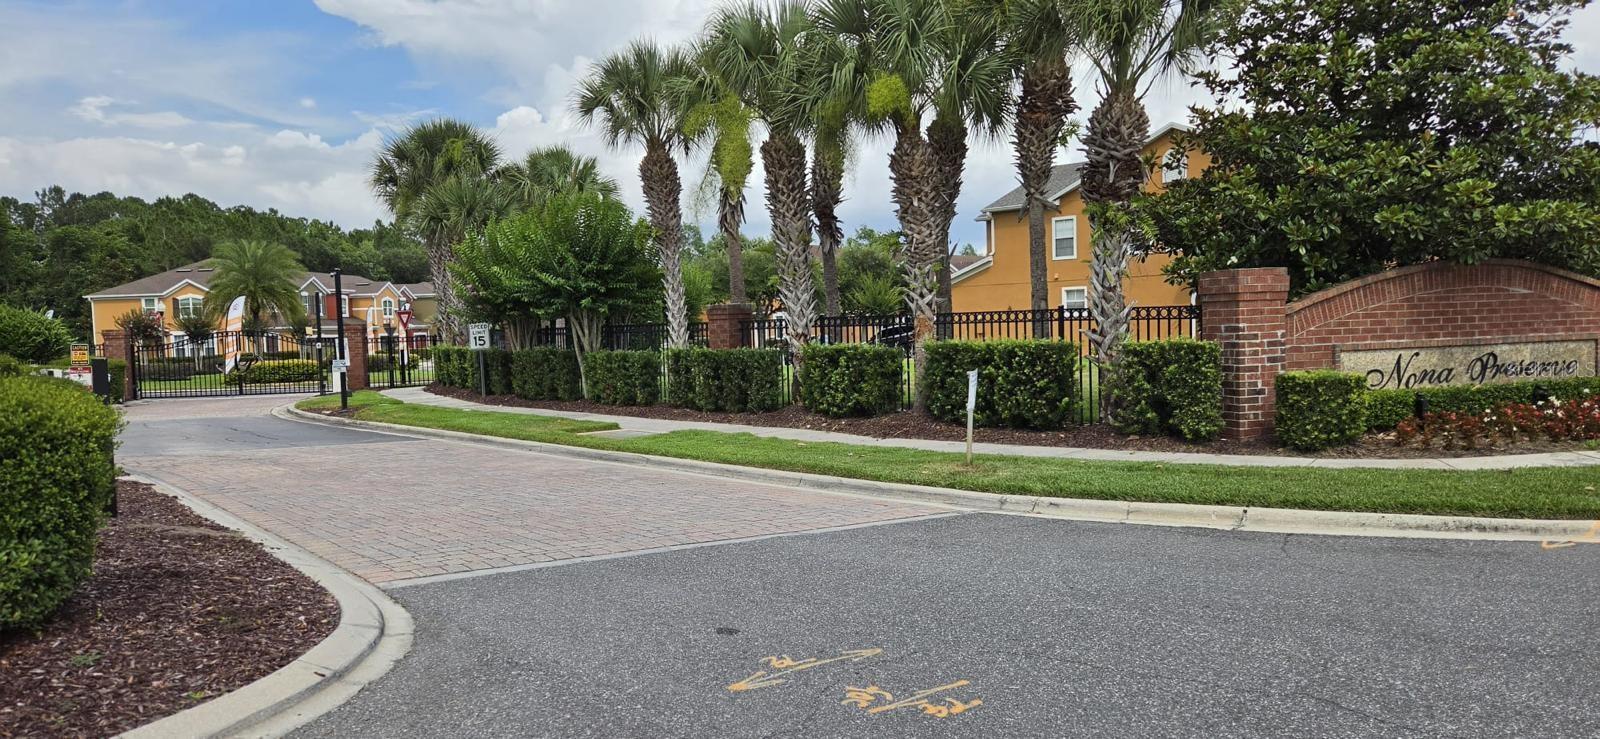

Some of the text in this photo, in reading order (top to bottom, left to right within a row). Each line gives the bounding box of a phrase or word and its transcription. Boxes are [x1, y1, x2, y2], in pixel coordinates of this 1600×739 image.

[474, 336, 486, 346] 15
[1366, 351, 1577, 390] Nona Preserve
